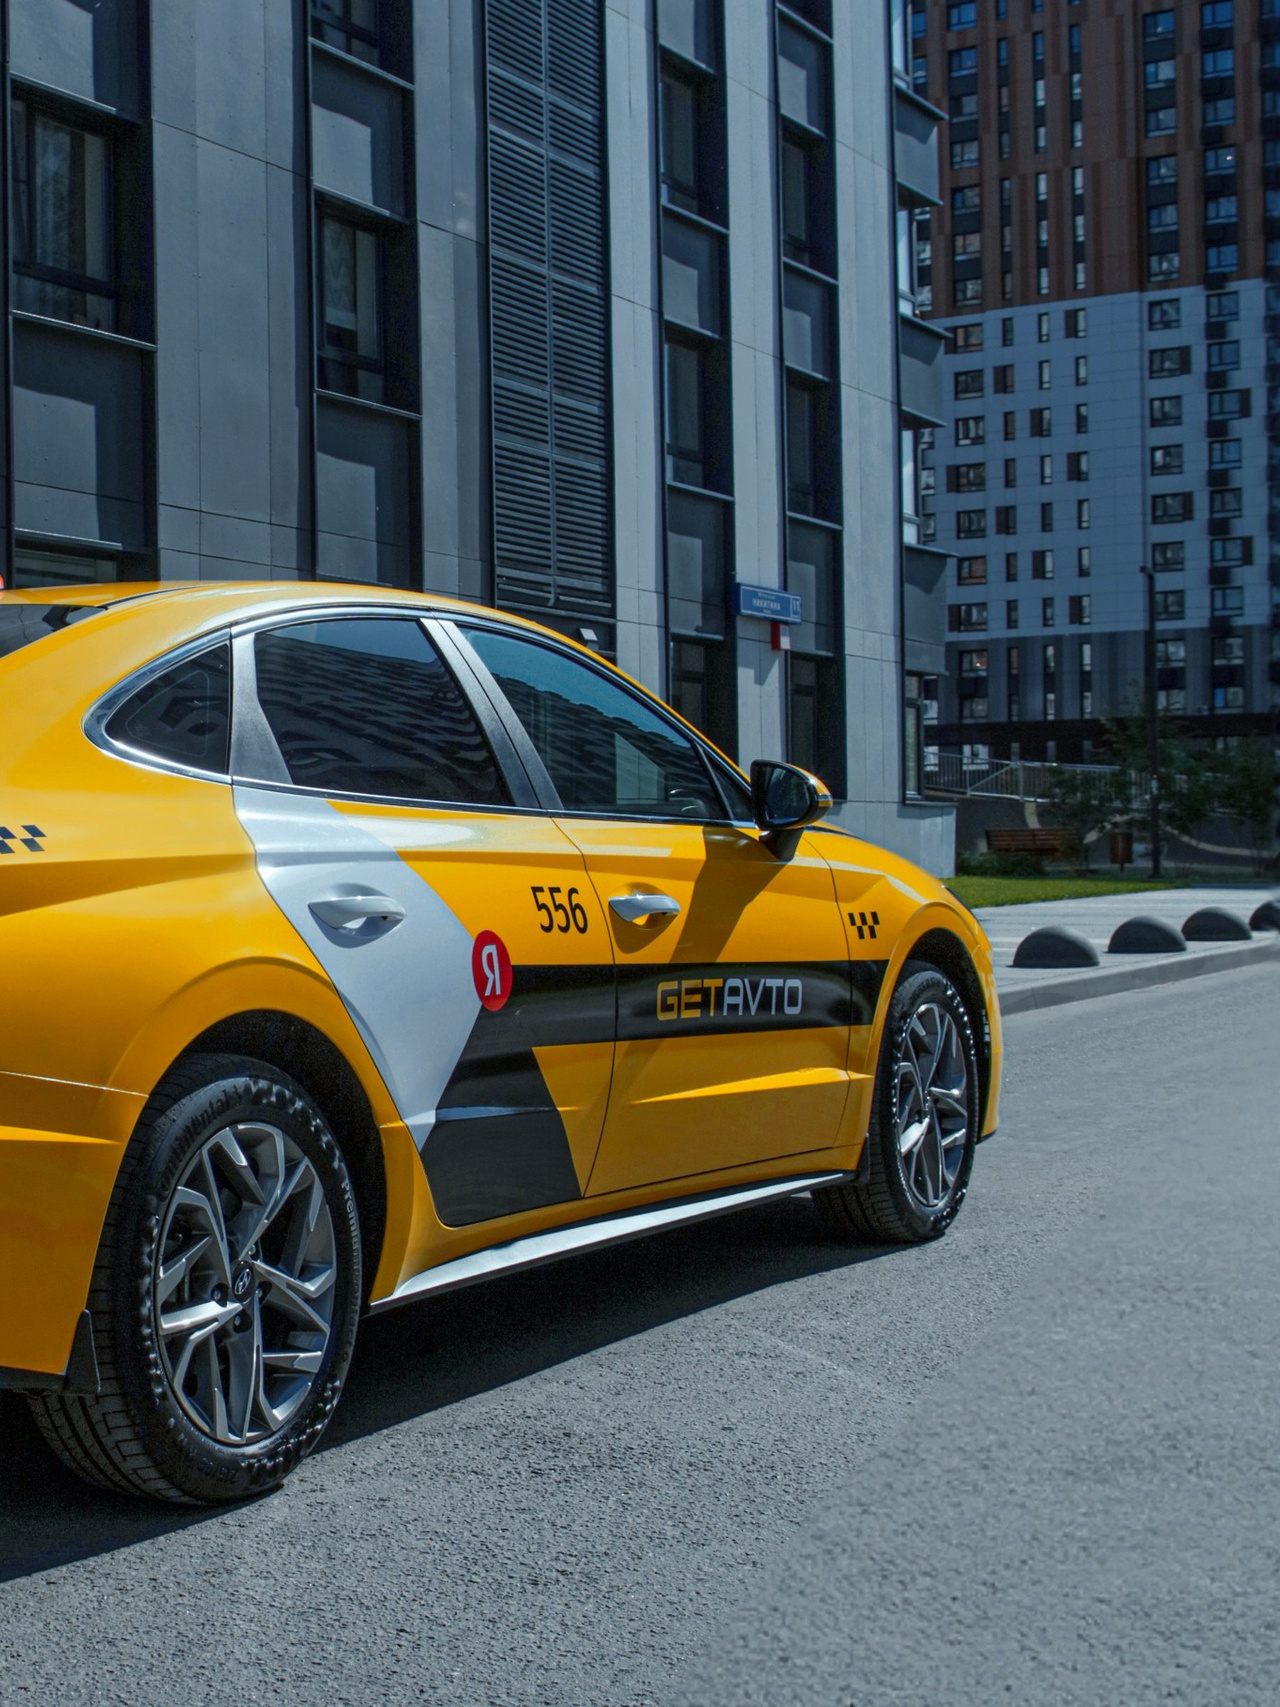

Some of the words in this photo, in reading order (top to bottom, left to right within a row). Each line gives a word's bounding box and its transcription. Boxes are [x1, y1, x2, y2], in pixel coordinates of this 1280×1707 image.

[530, 886, 588, 934] 556
[481, 944, 501, 997] Я
[657, 978, 803, 1021] GETAVTO
